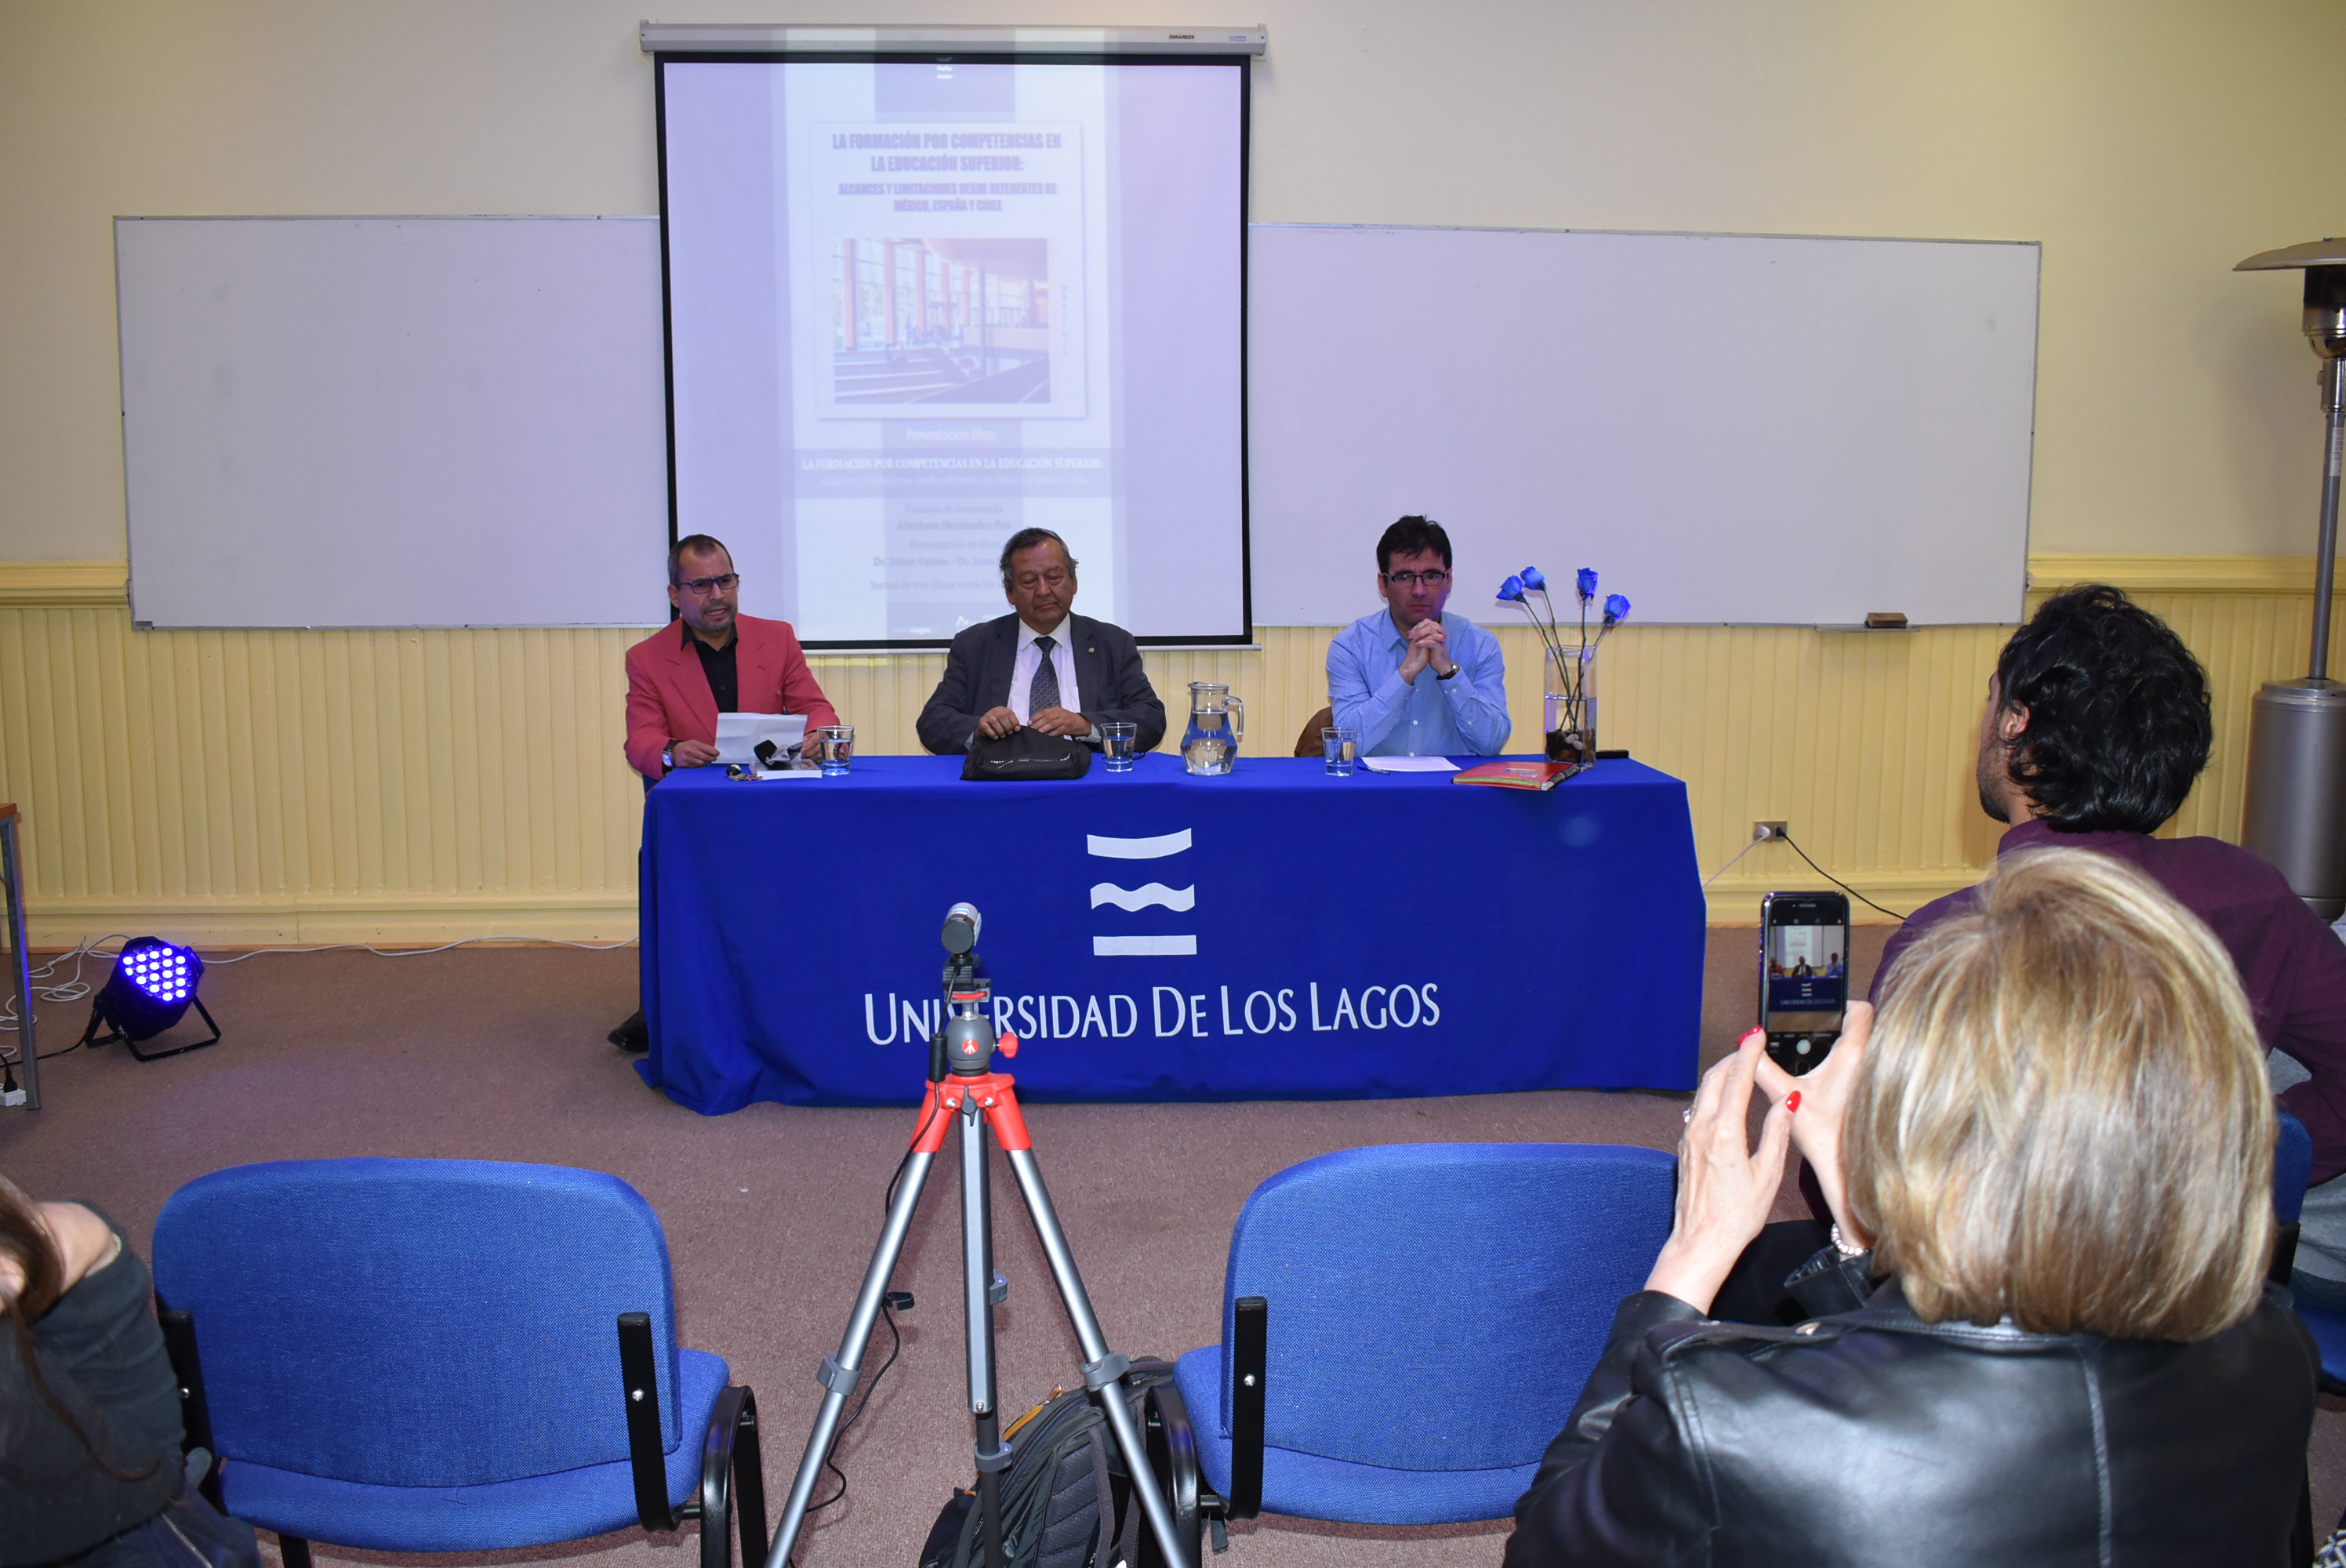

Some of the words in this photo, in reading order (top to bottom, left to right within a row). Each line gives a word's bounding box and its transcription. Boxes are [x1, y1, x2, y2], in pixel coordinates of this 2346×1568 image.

[833, 133, 847, 150] LA
[850, 131, 921, 149] FORMACIÓN
[924, 133, 948, 149] POR
[951, 133, 1043, 149] COMPETENCIAS
[1046, 132, 1061, 149] EN
[871, 156, 885, 172] LA
[888, 154, 957, 172] EDUCACIÓN
[960, 156, 1023, 171] SUPERIOR:
[838, 183, 884, 194] ALCANCES
[886, 183, 892, 194] Y
[894, 183, 957, 194] LIMITACIONES
[960, 183, 987, 194] DESDE
[990, 183, 1044, 194] REFERENTES
[1045, 183, 1056, 194] DE
[894, 198, 931, 212] MÉXICO,
[933, 198, 967, 211] ESPAÑA
[968, 200, 975, 211] Y
[977, 200, 1002, 211] CHILE
[906, 428, 968, 441] Presentación
[971, 427, 997, 440] libro:
[801, 459, 814, 470] LA
[815, 457, 873, 470] FORMACIÓN
[874, 459, 893, 469] POR
[895, 459, 968, 469] COMPETENCIAS
[969, 459, 982, 469] EN
[984, 459, 995, 469] LA
[999, 456, 1051, 469] EDUCACIÓN
[1054, 458, 1103, 468] SUPERIOR:
[865, 993, 1138, 1045] UNIRSIDAD
[1153, 986, 1208, 1037] DE
[1221, 985, 1298, 1035] LOS
[1311, 982, 1440, 1031] LAGOS
